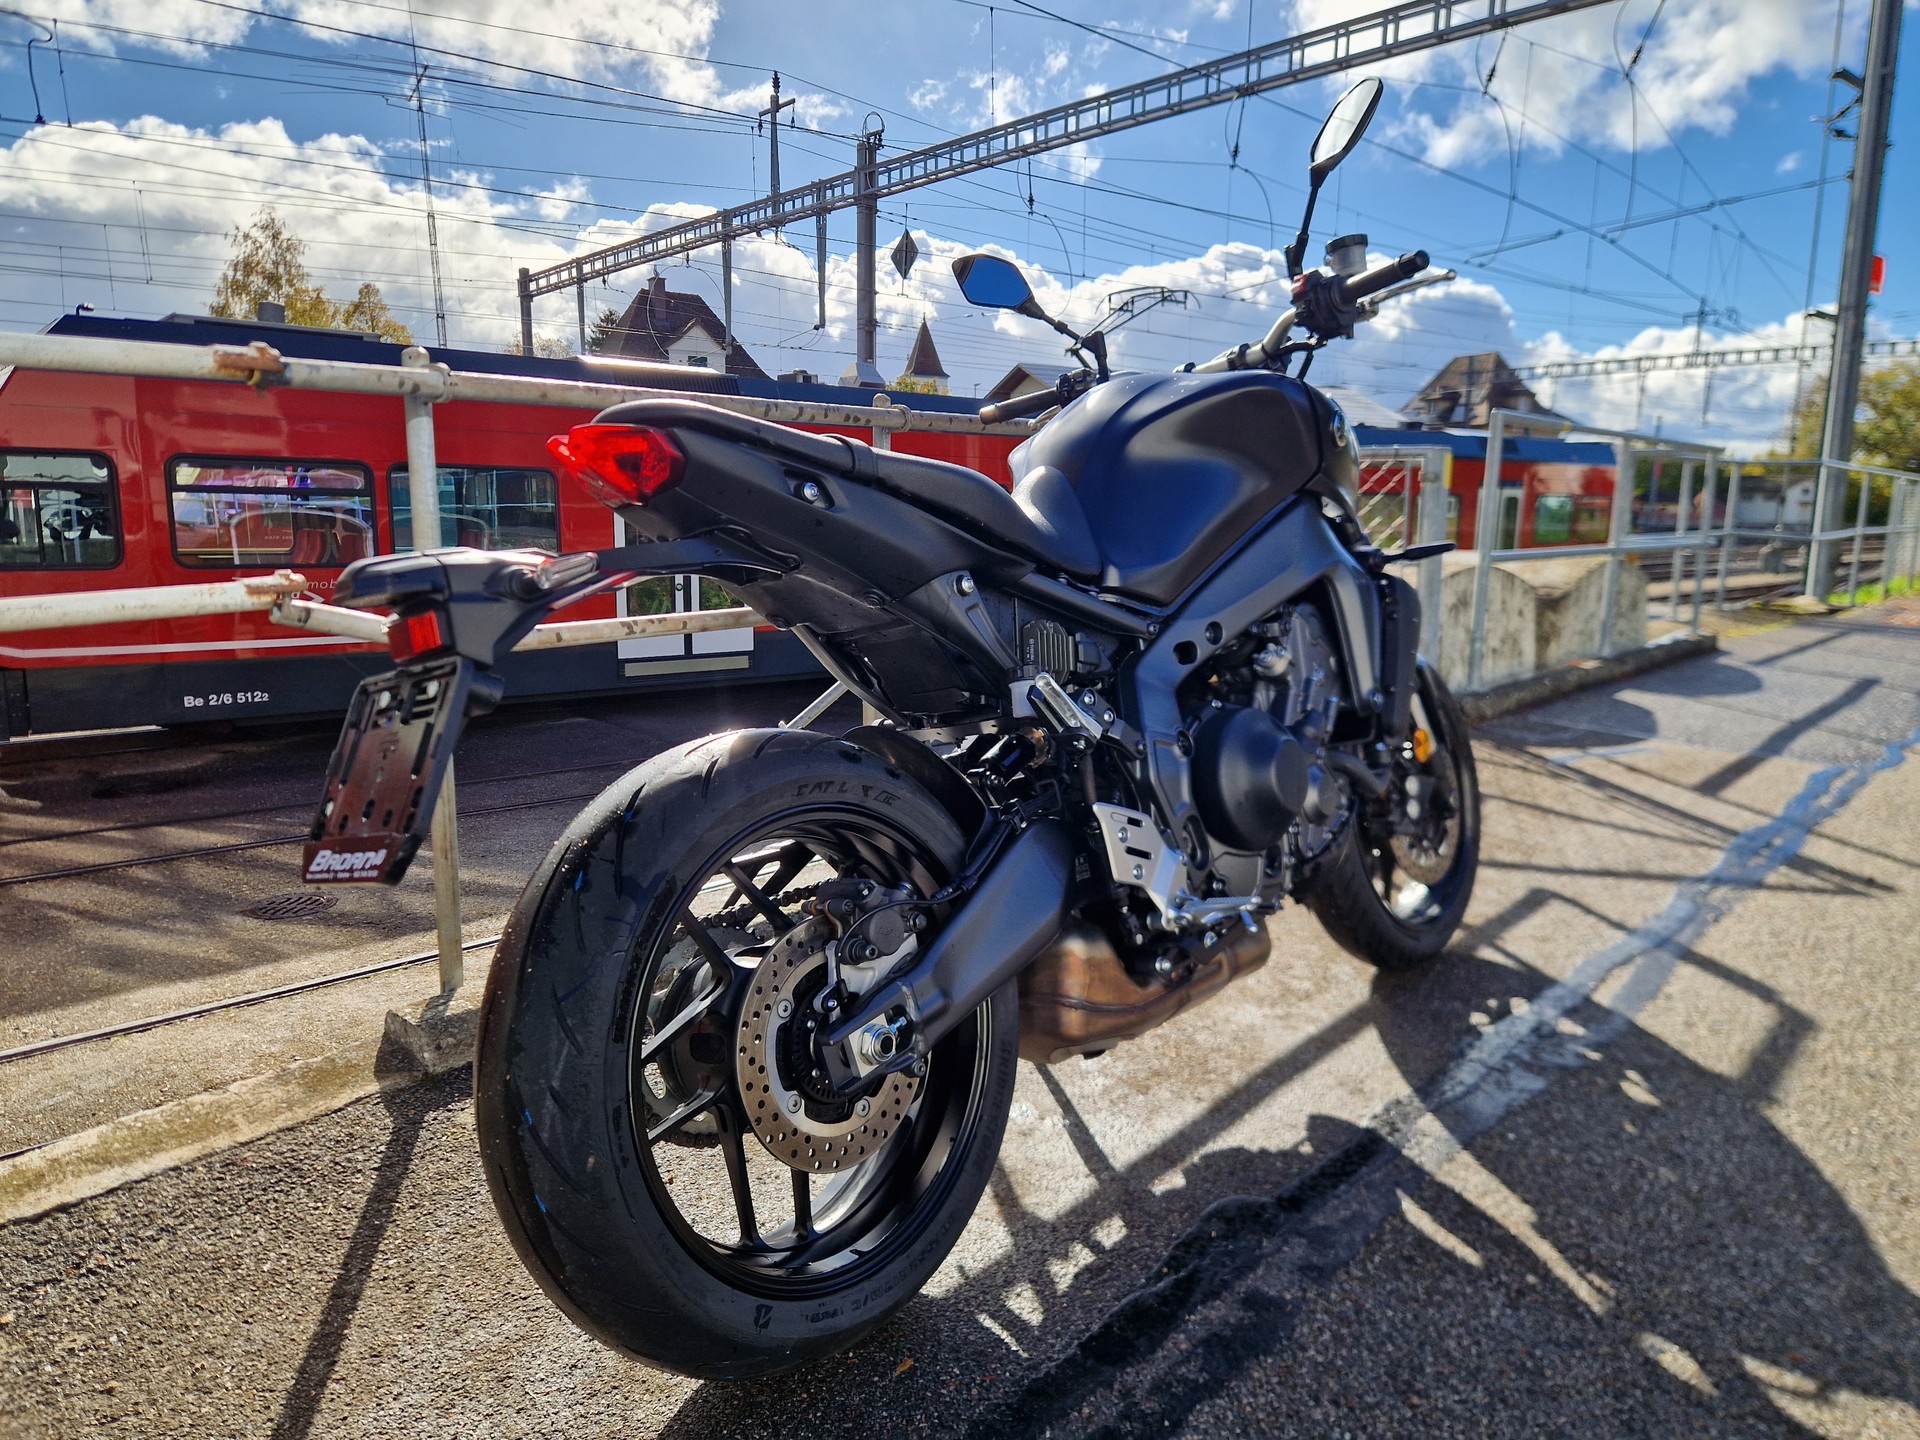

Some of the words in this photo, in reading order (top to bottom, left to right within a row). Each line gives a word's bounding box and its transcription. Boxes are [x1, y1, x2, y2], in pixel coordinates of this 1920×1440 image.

[306, 578, 337, 589] mob
[183, 695, 204, 708] Be
[208, 693, 233, 706] 2/6
